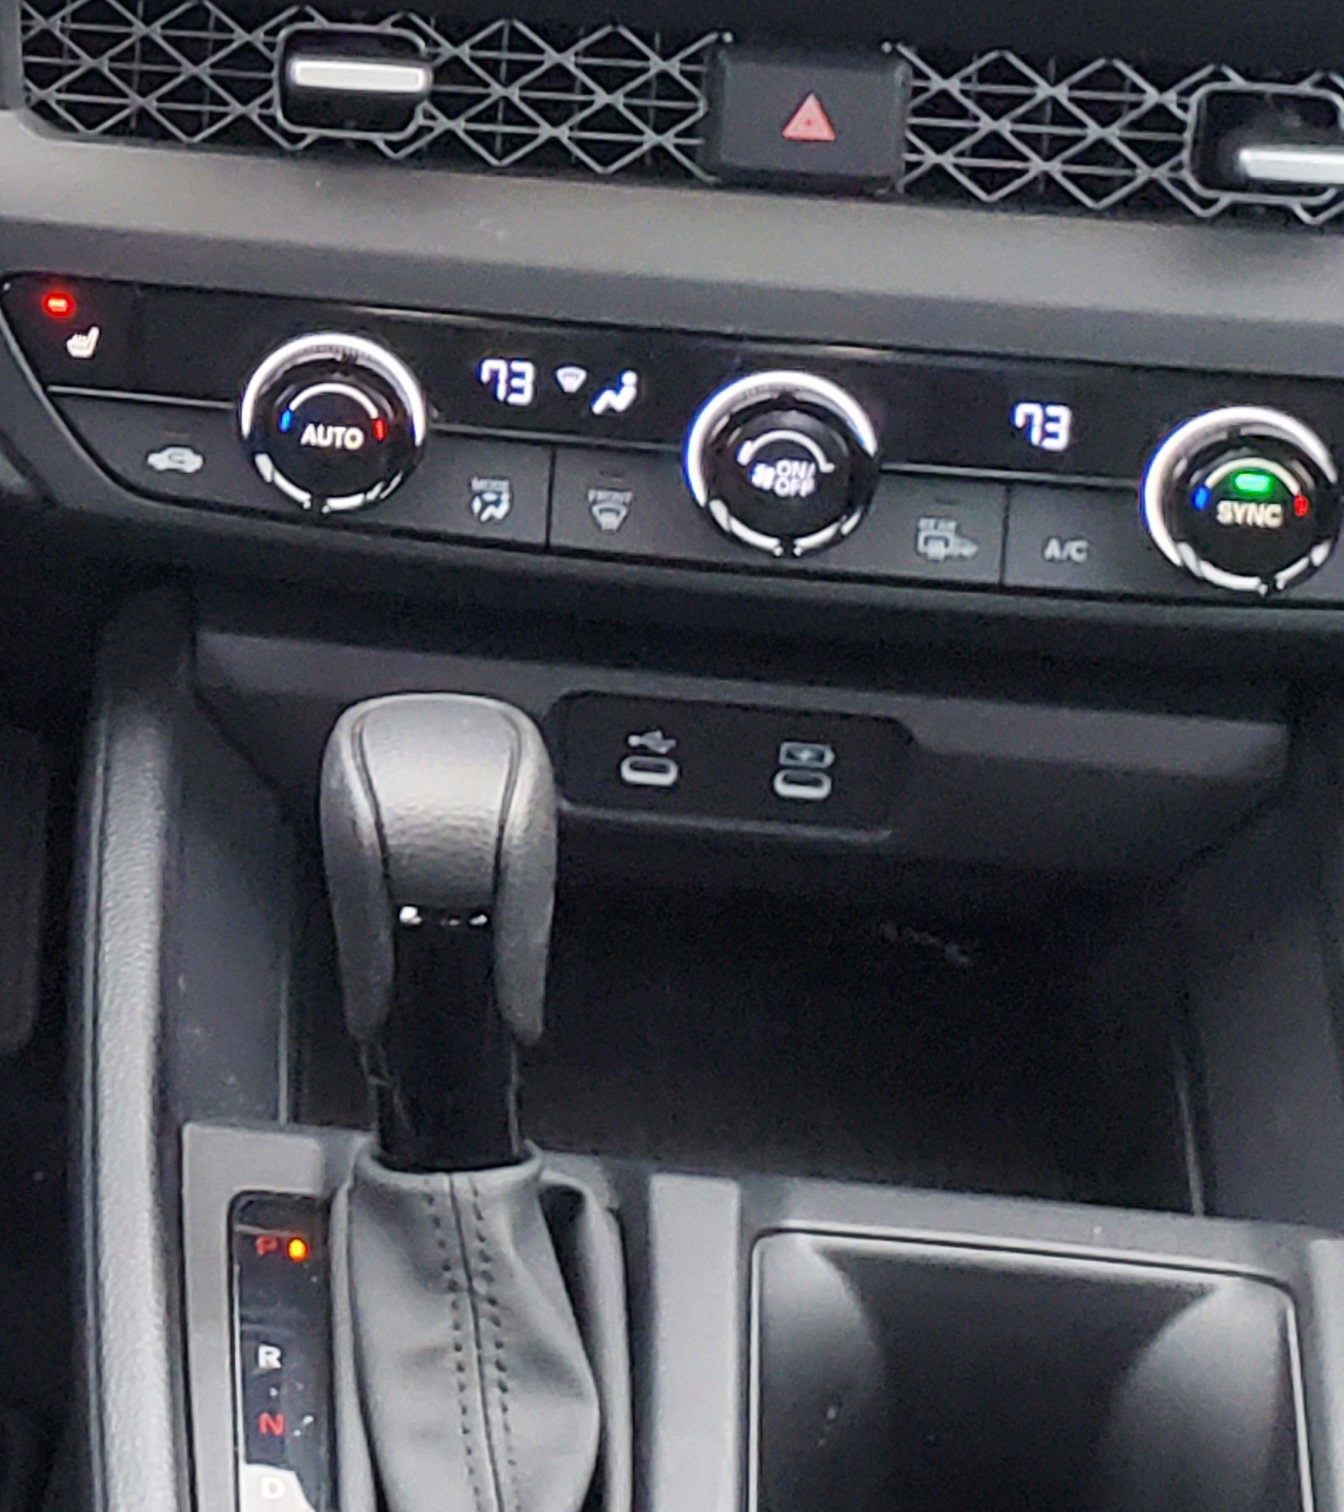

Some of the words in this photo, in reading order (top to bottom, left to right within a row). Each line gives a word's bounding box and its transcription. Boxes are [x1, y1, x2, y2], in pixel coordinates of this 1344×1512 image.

[479, 358, 535, 406] 73
[300, 423, 364, 450] AUTO
[1014, 402, 1072, 451] 73
[1216, 500, 1283, 528] SYNC
[1045, 539, 1088, 564] A/C
[255, 1236, 278, 1257] P
[258, 1343, 283, 1369] R
[259, 1411, 284, 1436] N
